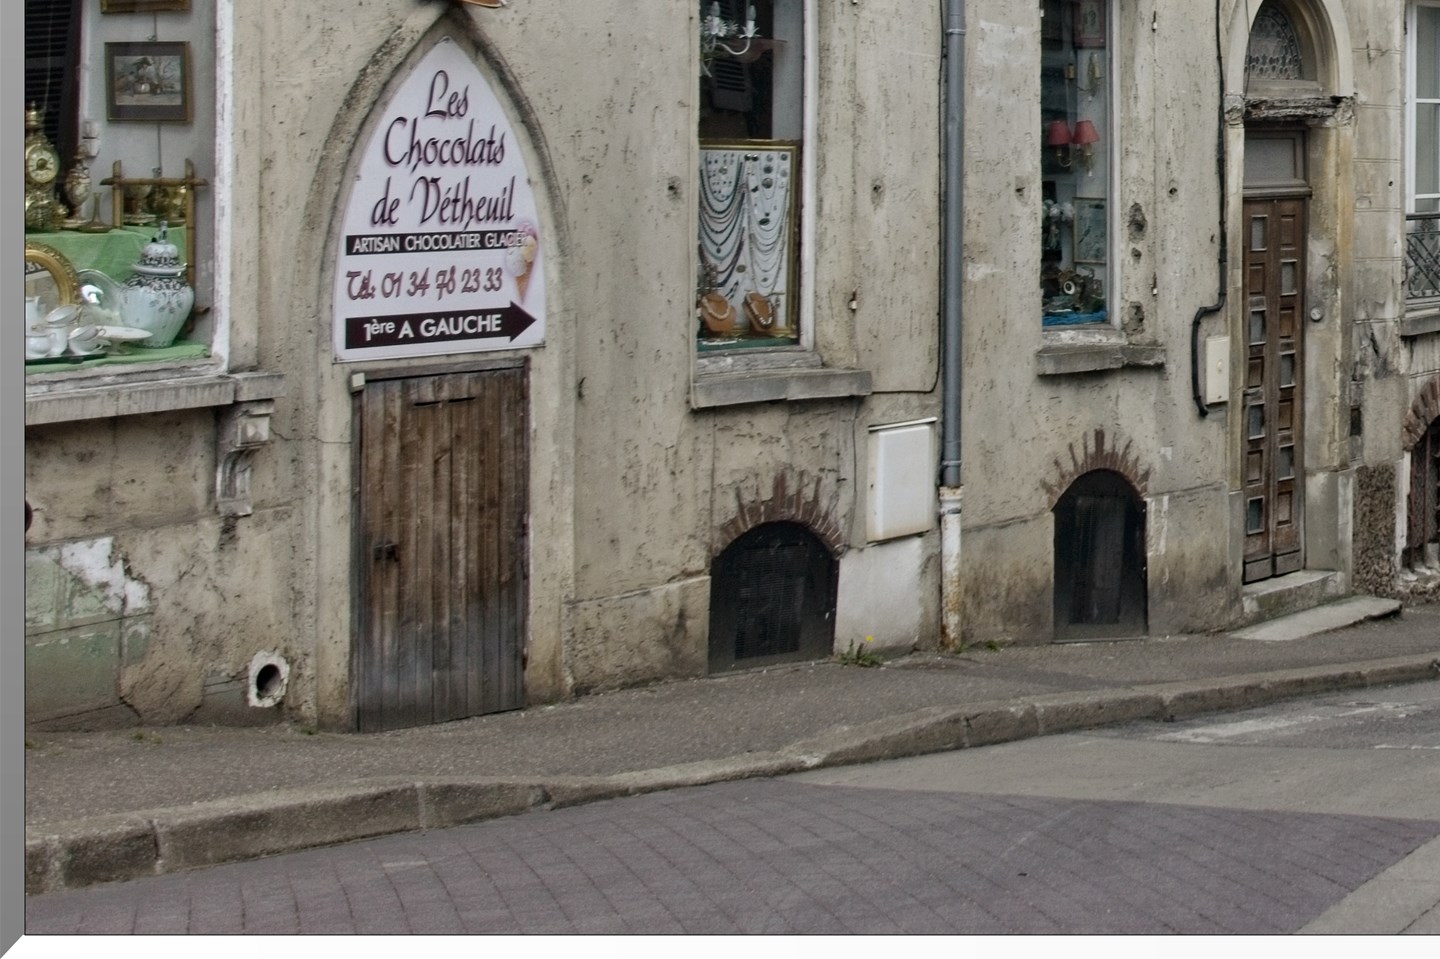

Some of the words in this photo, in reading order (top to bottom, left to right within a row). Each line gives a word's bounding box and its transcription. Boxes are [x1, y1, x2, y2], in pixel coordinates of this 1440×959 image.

[425, 70, 470, 119] Les
[384, 116, 506, 173] Chocolats
[371, 176, 401, 225] de
[408, 176, 516, 231] Vétheuil
[352, 236, 401, 253] ARTISAN
[405, 234, 481, 251] CHOCOLATIER
[485, 231, 529, 248] GLACIER
[381, 271, 404, 298] 01
[407, 267, 430, 297] 34
[435, 264, 457, 301] 78
[461, 268, 482, 293] 23
[484, 266, 504, 292] 33
[363, 318, 396, 341] 1ère
[398, 320, 414, 339] A
[420, 313, 502, 337] GAUCHE
